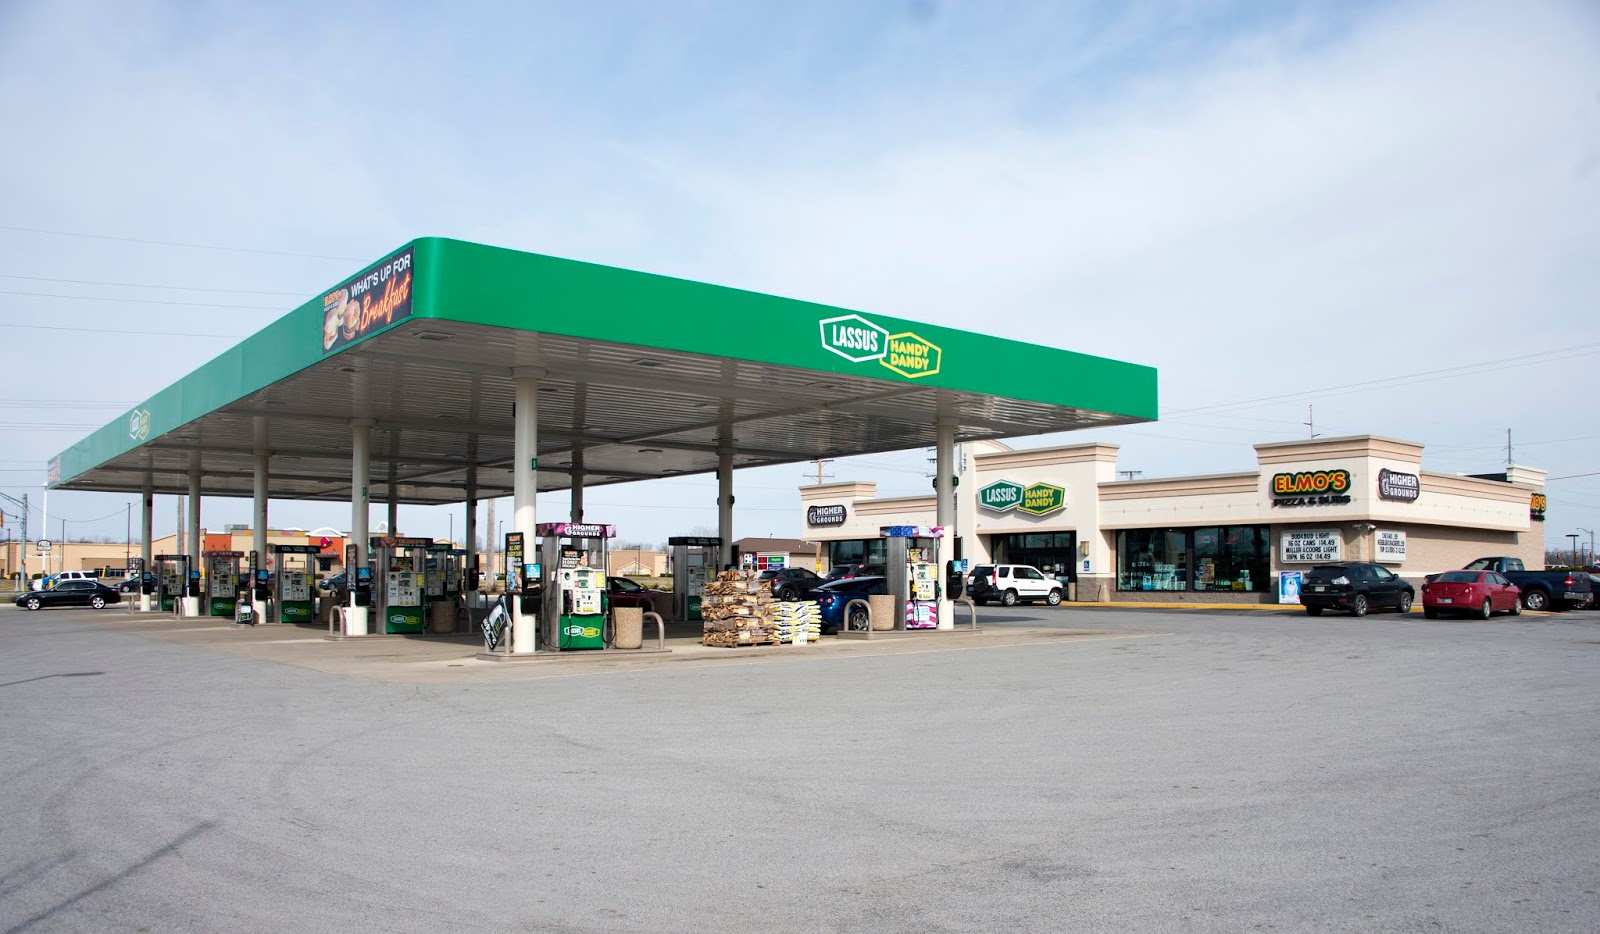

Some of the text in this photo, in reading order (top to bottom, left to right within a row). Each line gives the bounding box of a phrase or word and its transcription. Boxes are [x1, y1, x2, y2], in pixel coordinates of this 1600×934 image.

[350, 254, 410, 298] WHAT'S UP FOR
[360, 272, 411, 331] Breakfast
[832, 324, 878, 352] LASSUS
[890, 340, 929, 357] HANDY
[890, 353, 929, 370] DANDY
[1275, 472, 1346, 492] ELMO'S
[1390, 474, 1417, 487] HIGHER
[986, 486, 1017, 503] LASSUS
[1024, 488, 1054, 499] HANDY
[1274, 498, 1306, 507] PIZZA
[1318, 495, 1351, 504] SUBS
[1390, 487, 1417, 498] GROUNDS
[816, 506, 842, 515] HIGHER
[1024, 497, 1054, 508] DANDY
